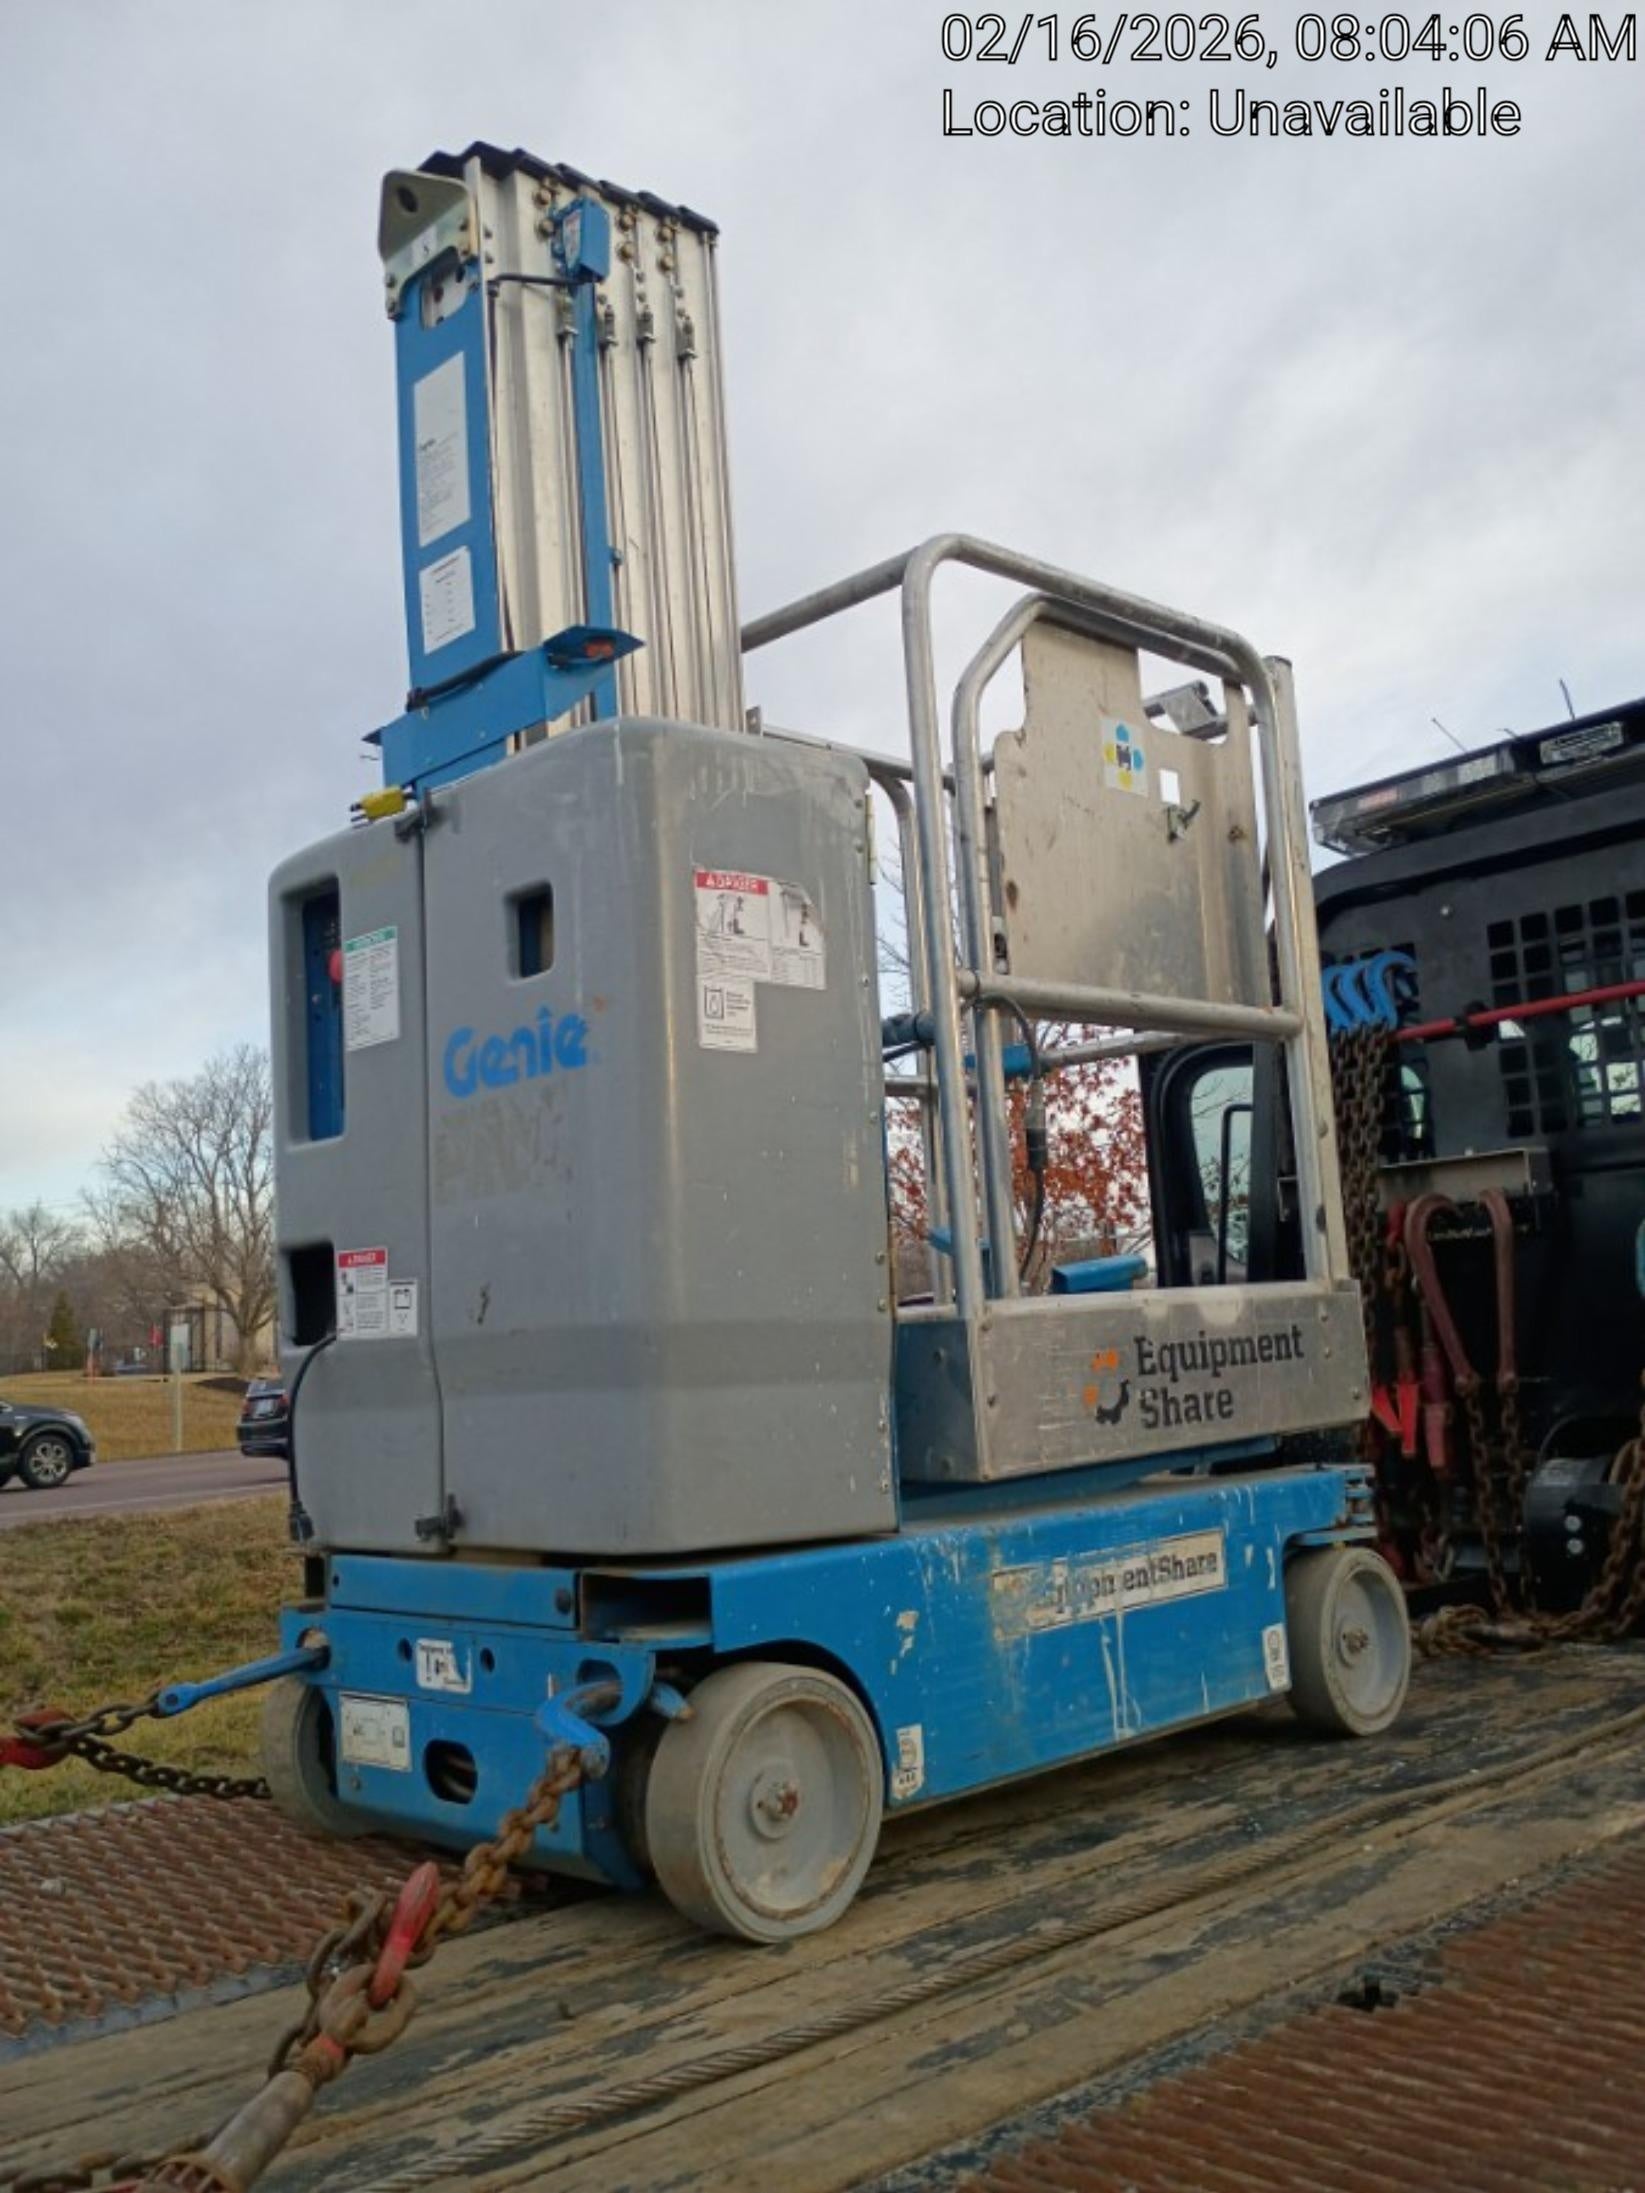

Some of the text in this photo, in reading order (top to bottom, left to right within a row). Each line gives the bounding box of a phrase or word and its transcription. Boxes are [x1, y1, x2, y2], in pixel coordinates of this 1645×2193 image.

[442, 1003, 590, 1099] Genie
[1133, 1325, 1305, 1382] Equipment
[1138, 1387, 1235, 1429] Share
